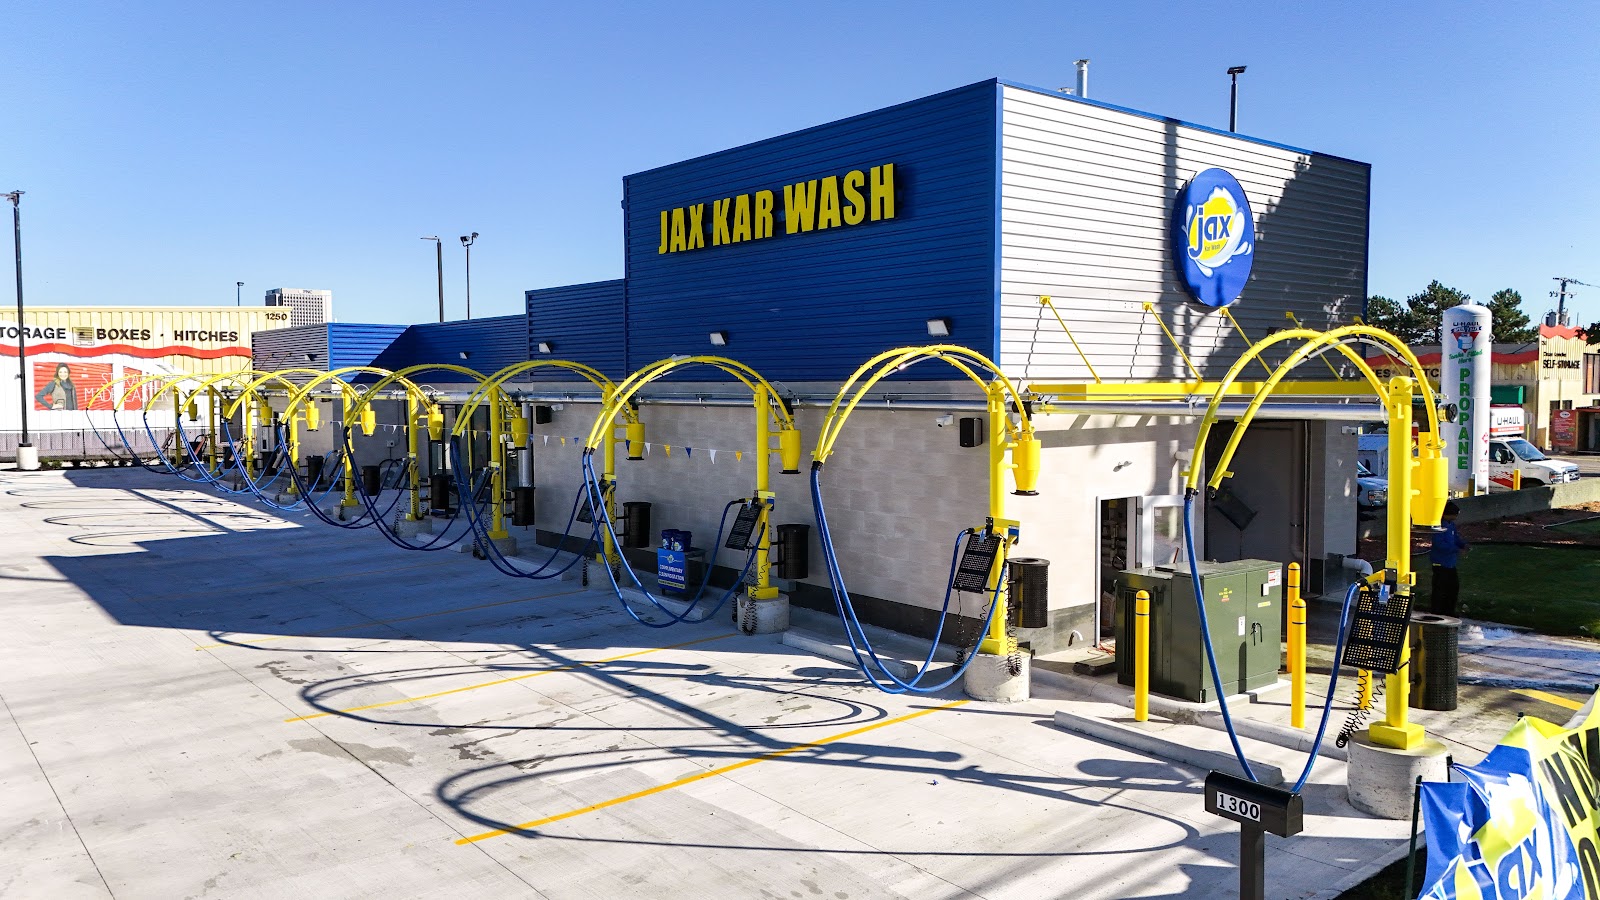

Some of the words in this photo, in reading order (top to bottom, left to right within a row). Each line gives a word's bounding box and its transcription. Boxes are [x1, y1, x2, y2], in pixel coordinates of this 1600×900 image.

[658, 203, 704, 254] JAX
[713, 190, 774, 246] KAR
[783, 163, 894, 234] WASH
[1188, 205, 1232, 258] jax
[265, 312, 287, 321] 1250
[0, 326, 66, 339] TORAGE
[97, 328, 151, 340] BOXES
[174, 329, 239, 342] HITCHES
[1458, 368, 1470, 469] PROPANE
[1497, 416, 1520, 425] U-HAUL
[1219, 794, 1260, 819] 1300
